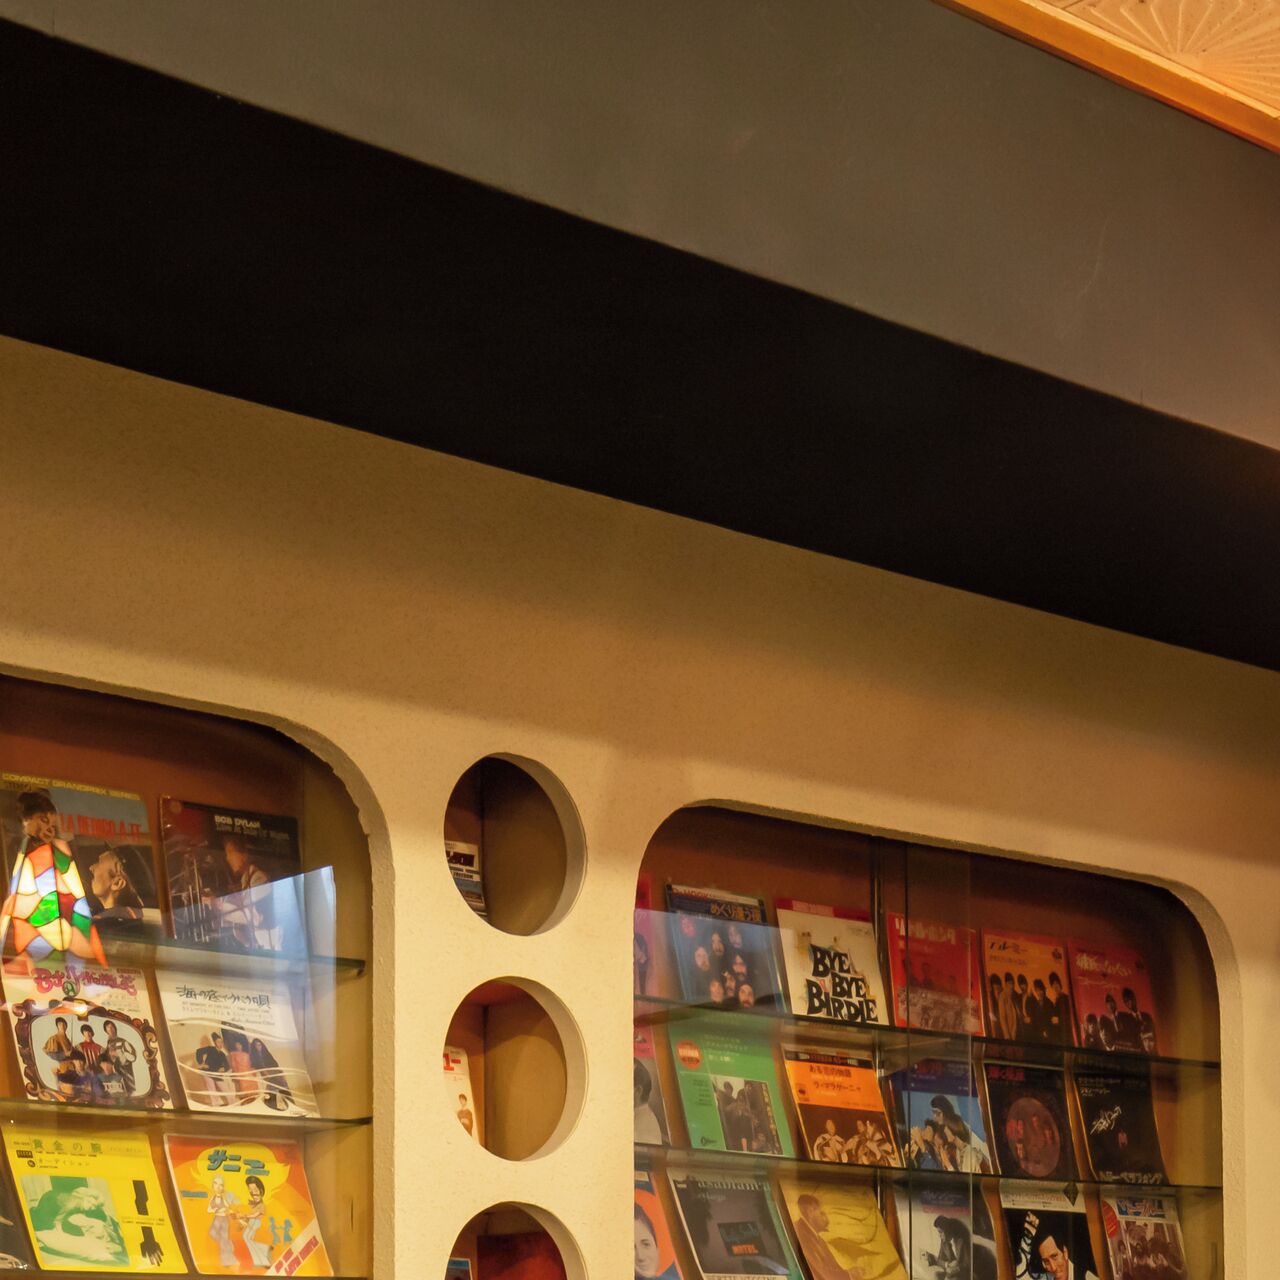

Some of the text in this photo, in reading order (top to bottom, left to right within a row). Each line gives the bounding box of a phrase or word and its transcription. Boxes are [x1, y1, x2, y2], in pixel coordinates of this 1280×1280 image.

[214, 815, 261, 829] BOB DYLAN
[810, 944, 851, 977] BYE
[831, 970, 867, 999] BYE
[806, 979, 878, 1024] BIRDIE
